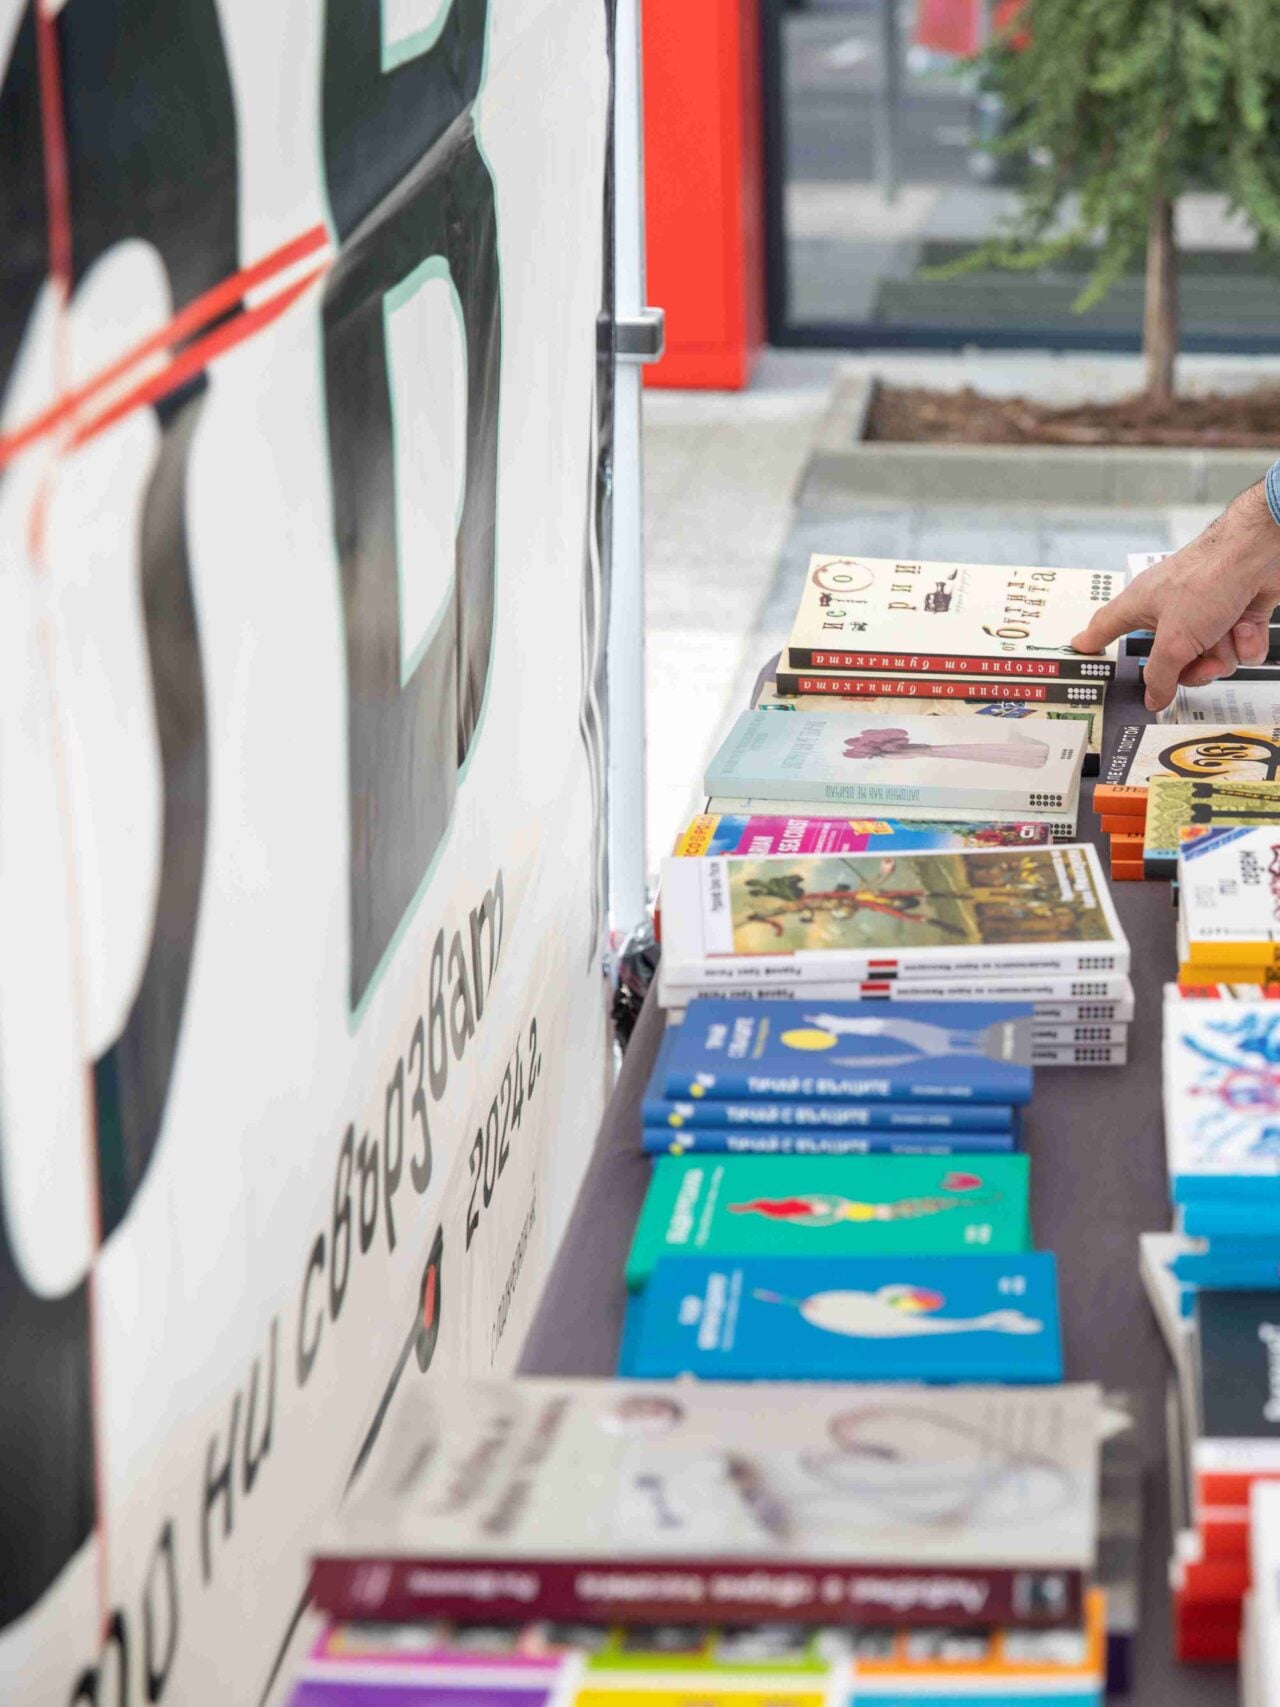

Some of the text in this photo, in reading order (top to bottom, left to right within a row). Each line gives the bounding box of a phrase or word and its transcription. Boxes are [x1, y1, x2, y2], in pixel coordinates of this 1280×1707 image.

[815, 654, 930, 668] бутилката
[981, 660, 1055, 674] истории
[803, 680, 1042, 698] истории от бутилката
[1103, 756, 1129, 785] АЛЕКСЕЙ
[1116, 726, 1140, 752] ТОЛСТОЙ
[777, 818, 810, 852] SEA COAST
[465, 1031, 525, 1253] 2024
[201, 1315, 279, 1584] ни
[296, 869, 504, 1388] свързват
